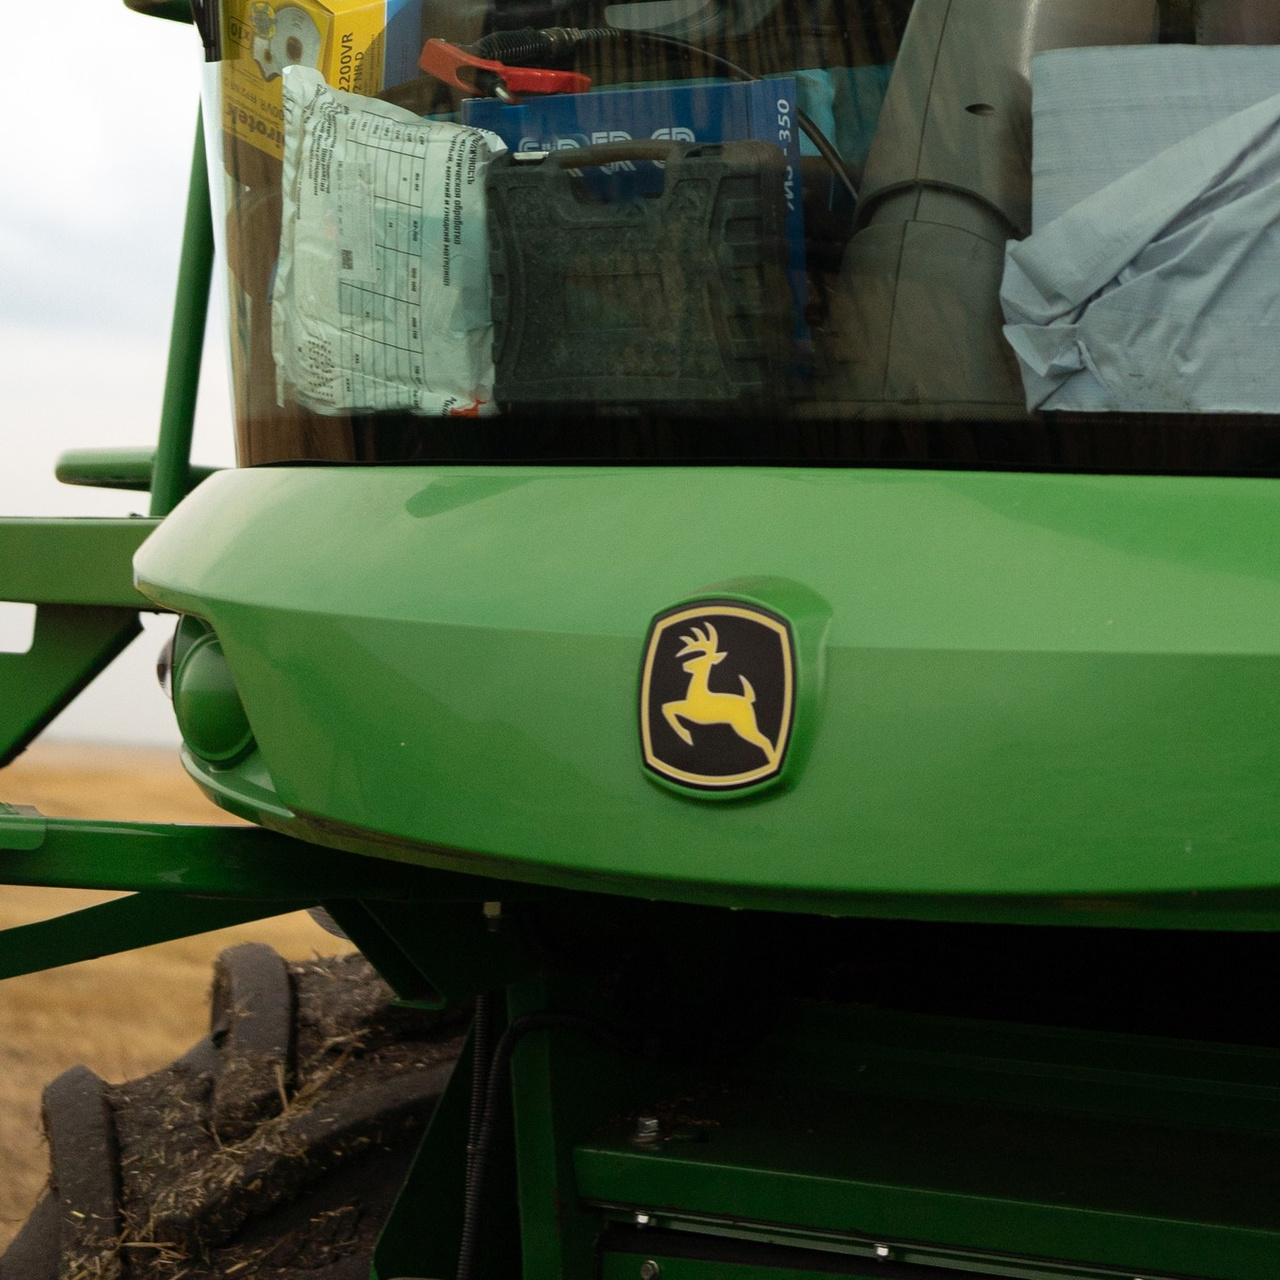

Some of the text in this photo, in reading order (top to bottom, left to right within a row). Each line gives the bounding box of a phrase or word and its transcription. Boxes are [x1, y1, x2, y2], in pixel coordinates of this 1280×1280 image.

[339, 32, 353, 93] 2200VR
[226, 102, 285, 149] irotek
[777, 99, 791, 142] 350
[453, 200, 464, 245] обработка
[442, 244, 450, 286] материал
